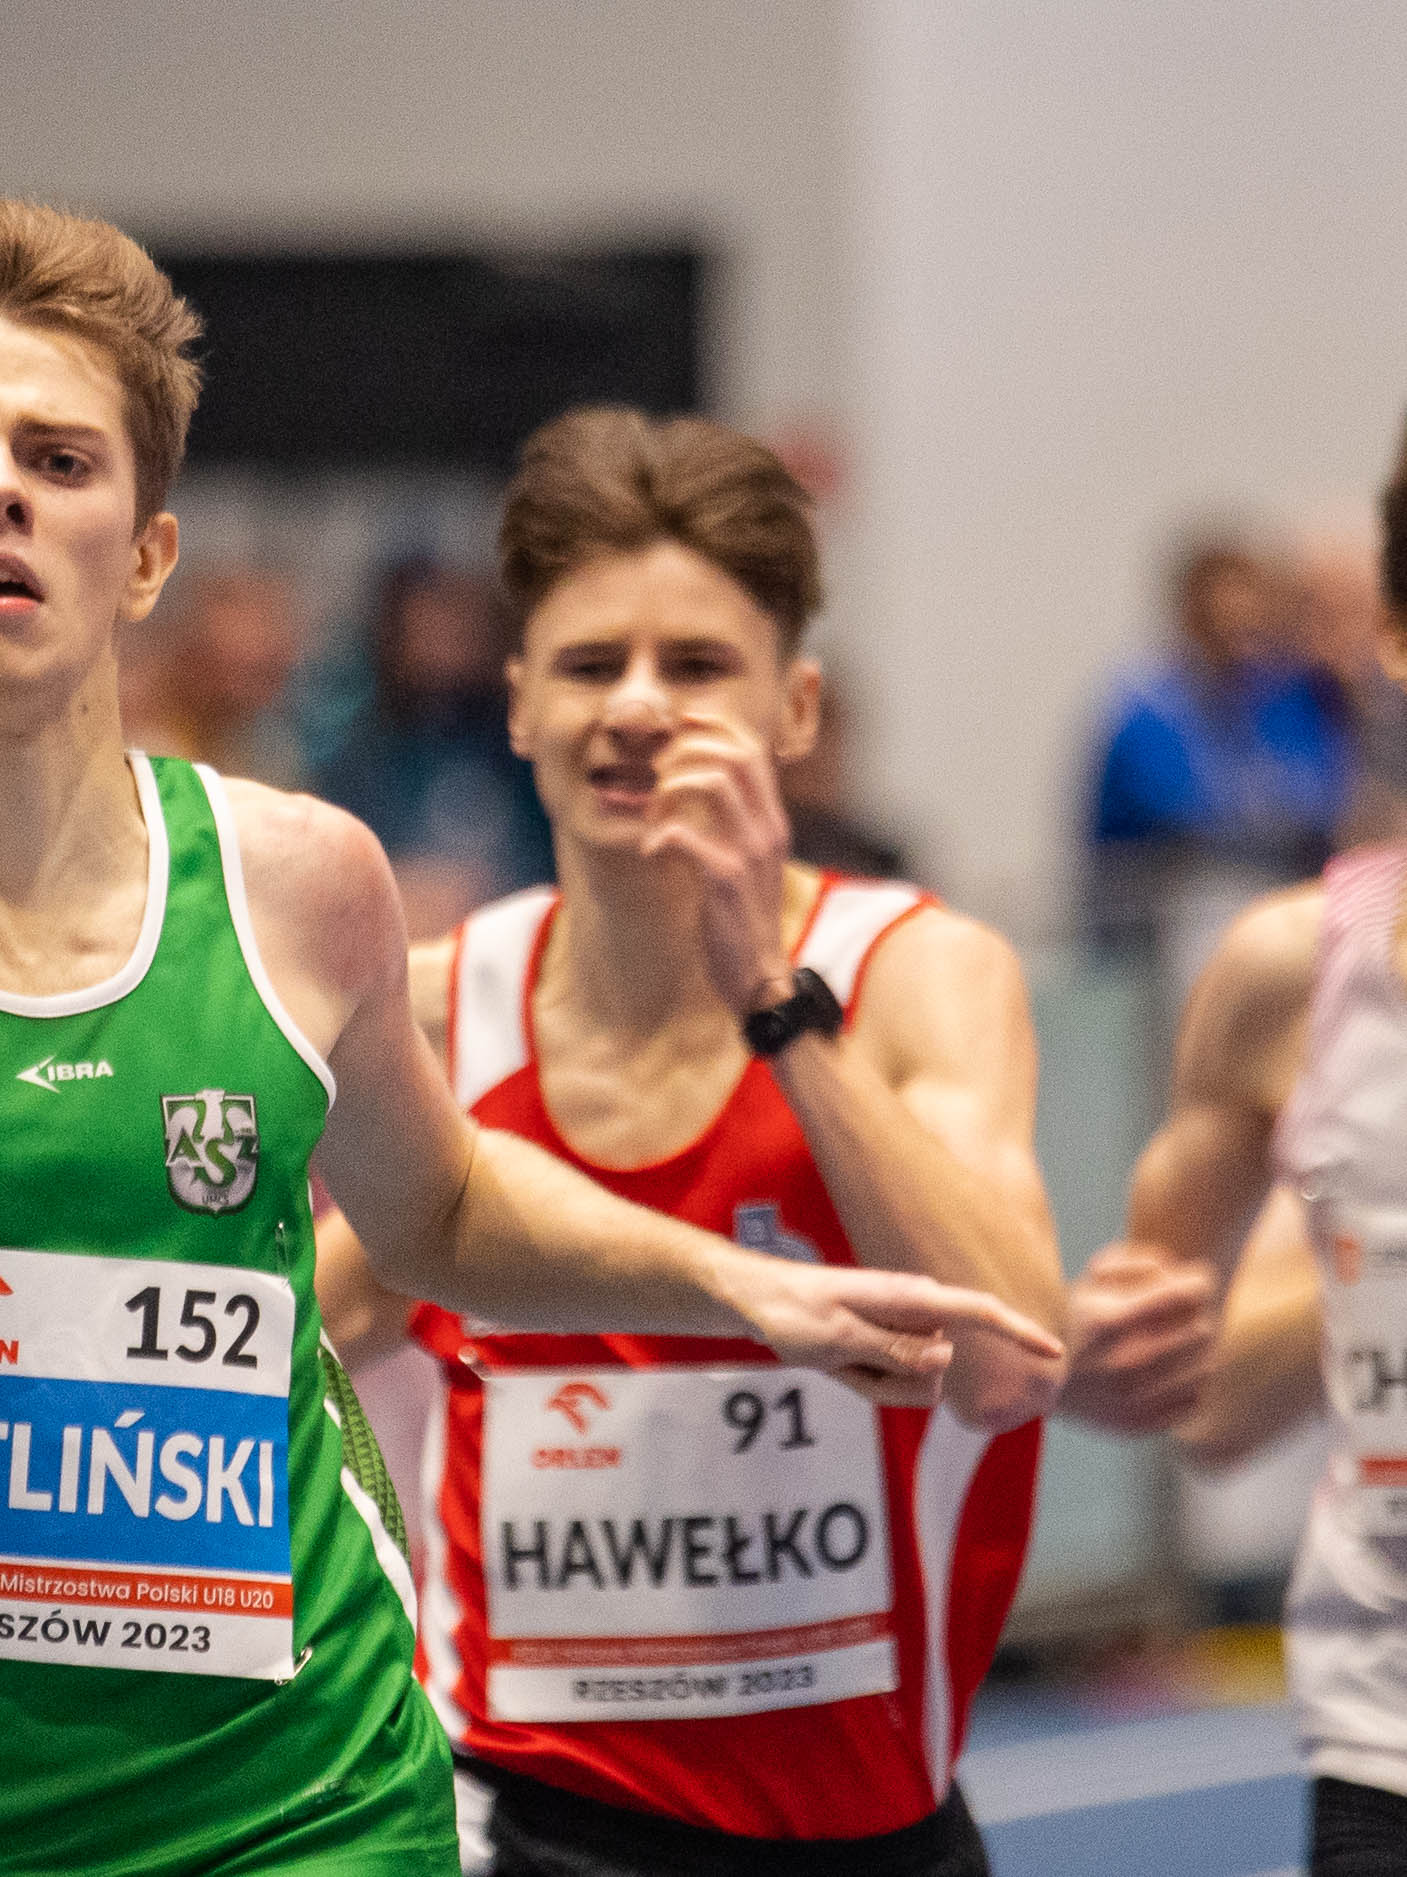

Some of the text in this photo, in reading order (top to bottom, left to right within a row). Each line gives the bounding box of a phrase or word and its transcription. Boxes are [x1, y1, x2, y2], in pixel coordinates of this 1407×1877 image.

[124, 1286, 261, 1370] 152
[722, 1387, 815, 1454] 91
[501, 1502, 870, 1591] HAWEŁKO
[0, 1573, 131, 1600] Mistrzostwa
[137, 1582, 198, 1604] Polski
[203, 1587, 236, 1607] U18
[240, 1590, 275, 1610] U20
[121, 1621, 212, 1653] 2023
